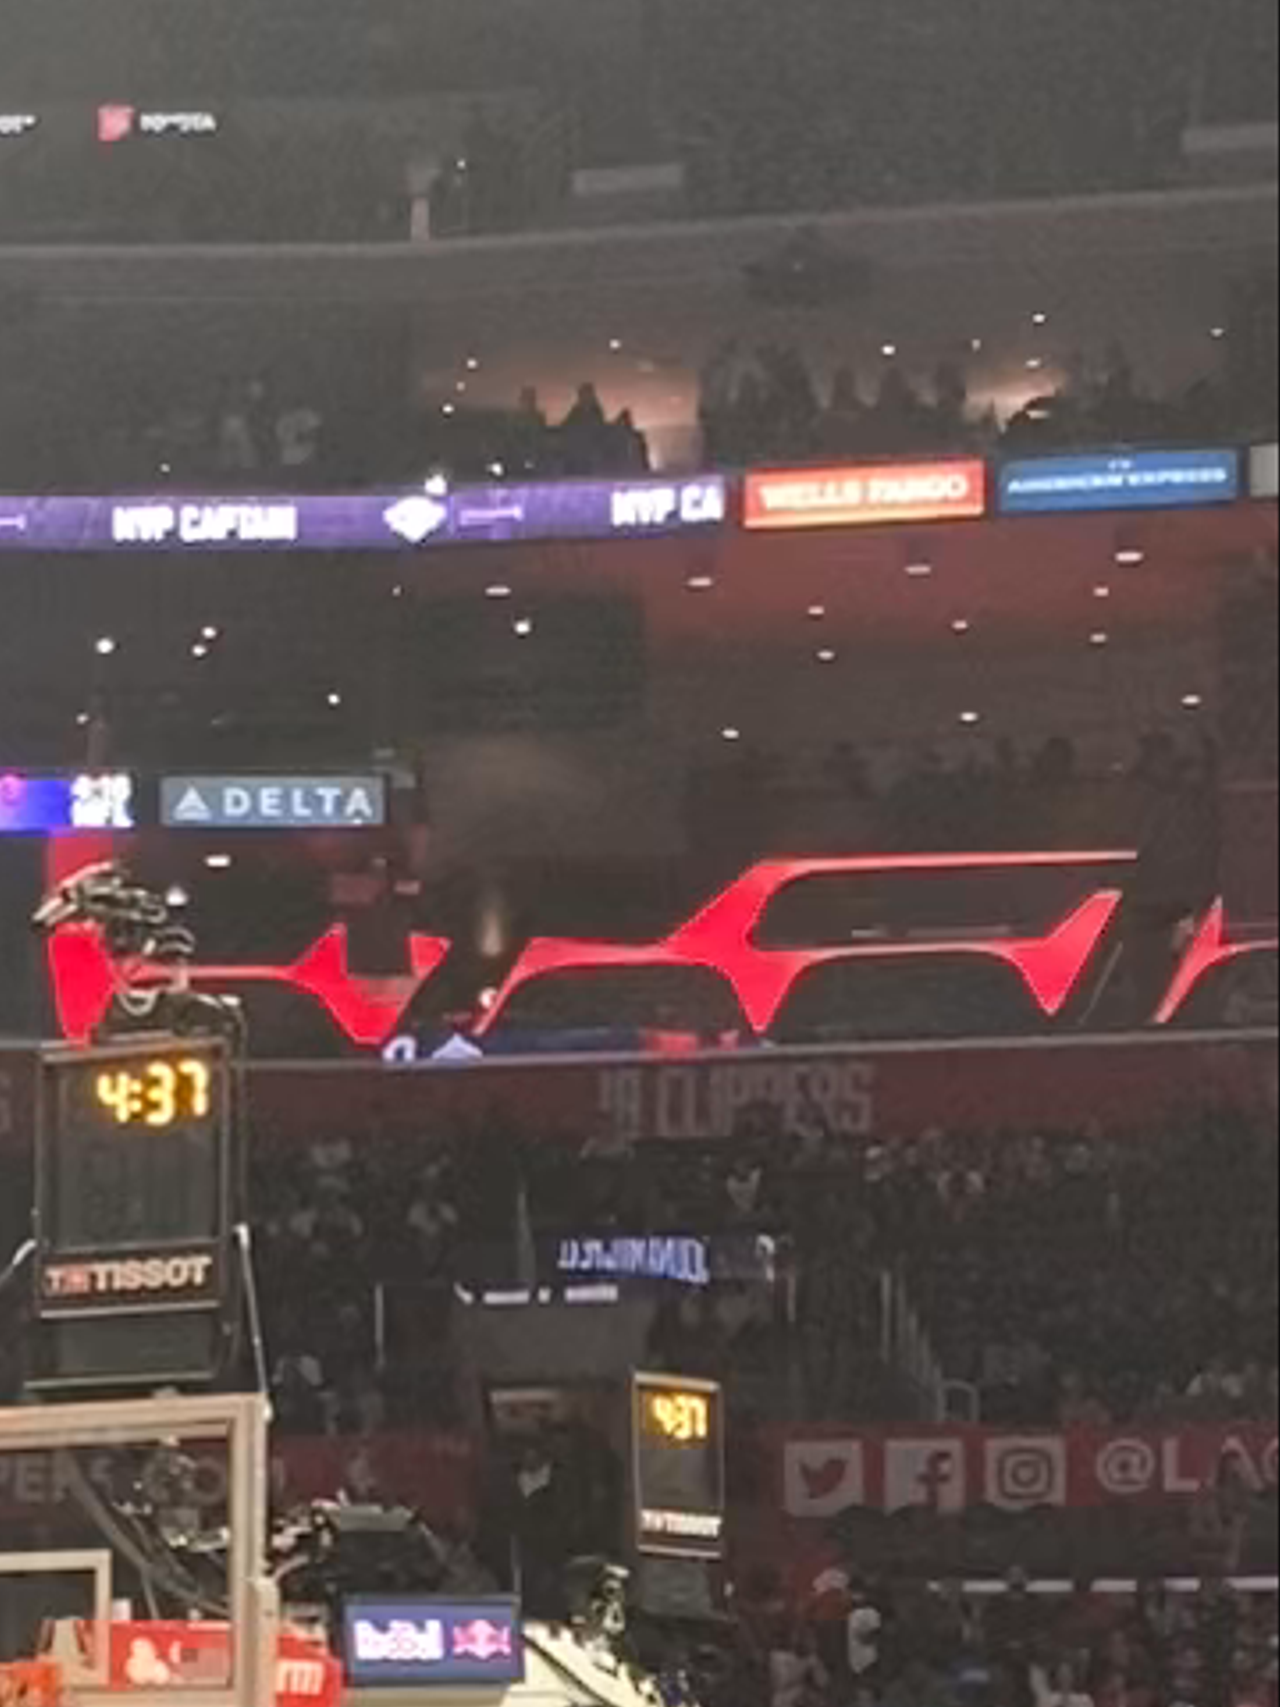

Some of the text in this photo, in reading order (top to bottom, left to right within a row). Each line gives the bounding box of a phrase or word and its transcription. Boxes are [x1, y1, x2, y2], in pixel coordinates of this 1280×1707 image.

[112, 505, 298, 542] MVP CAPTAIN
[611, 487, 675, 526] MVP
[222, 786, 373, 818] DELTA
[97, 1060, 208, 1125] 4:37
[89, 1255, 213, 1292] TISSOT
